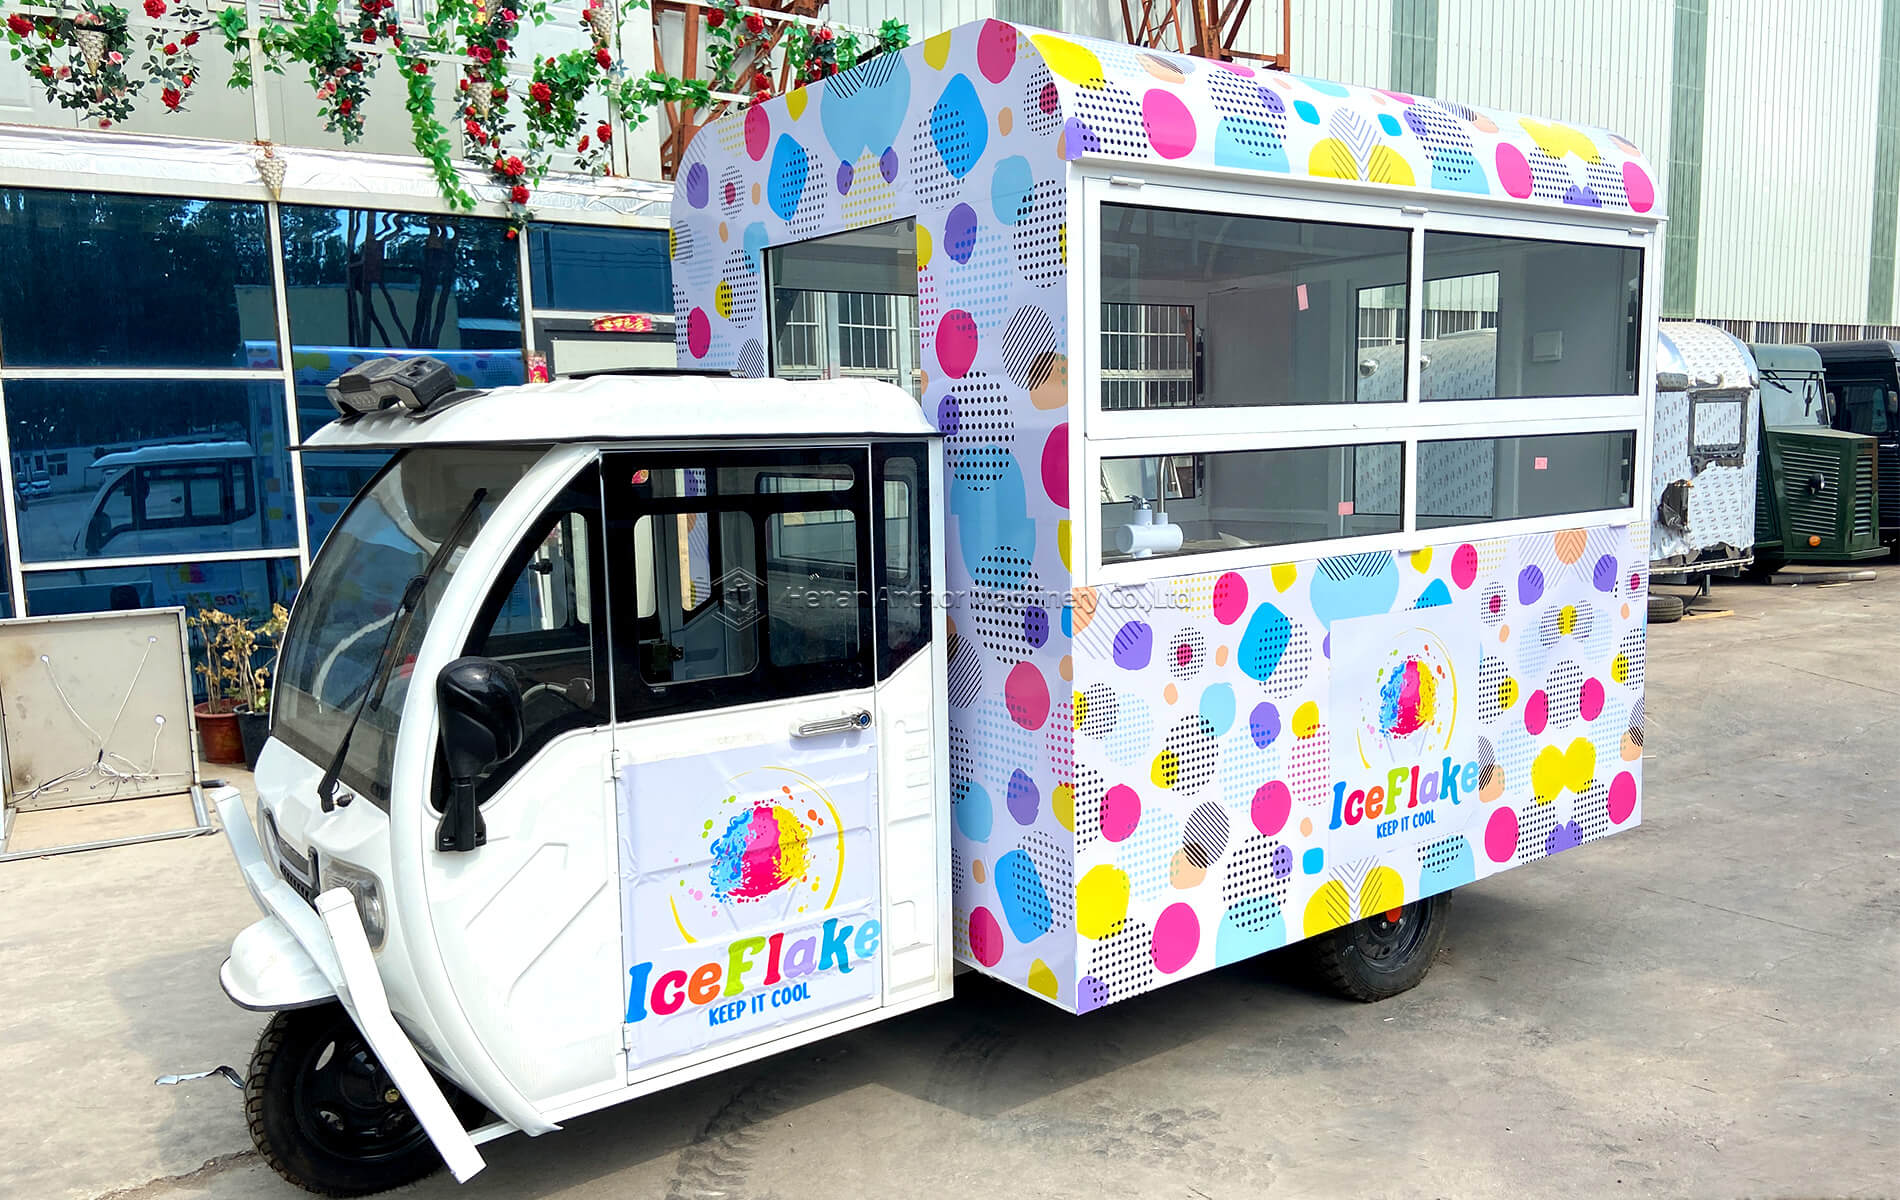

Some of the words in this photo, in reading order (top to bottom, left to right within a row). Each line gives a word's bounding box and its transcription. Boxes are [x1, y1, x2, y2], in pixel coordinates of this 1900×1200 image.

[1328, 756, 1479, 830] IceFlake
[1376, 819, 1399, 840] KEEP
[1401, 815, 1410, 833] IT
[1412, 808, 1436, 829] COOL
[625, 917, 880, 1024] IceFlake
[708, 1001, 747, 1027] KEEP
[751, 993, 767, 1014] IT
[772, 982, 811, 1008] COOL
